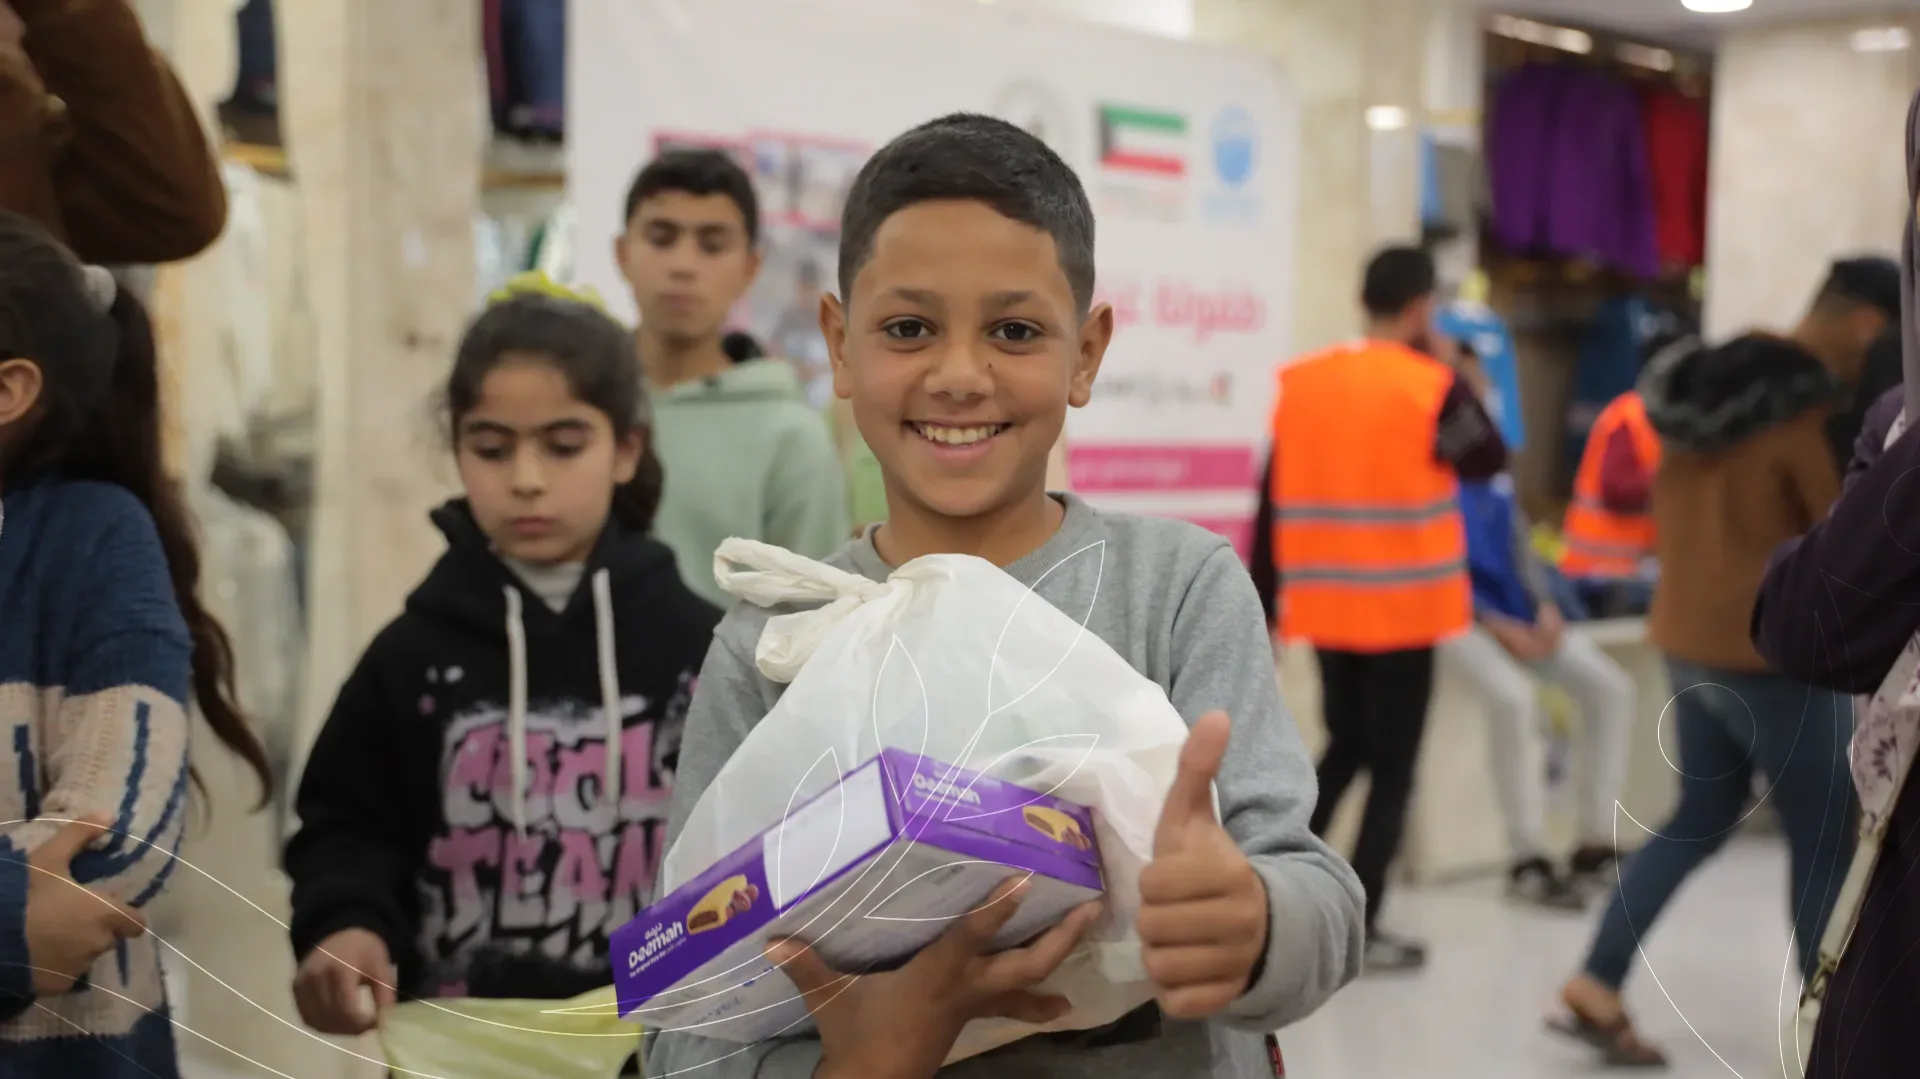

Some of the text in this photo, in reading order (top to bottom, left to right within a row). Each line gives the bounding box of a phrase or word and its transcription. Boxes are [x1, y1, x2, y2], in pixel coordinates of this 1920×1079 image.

[443, 720, 674, 835] COOL
[914, 772, 981, 805] Deemah
[629, 920, 684, 969] Deemah
